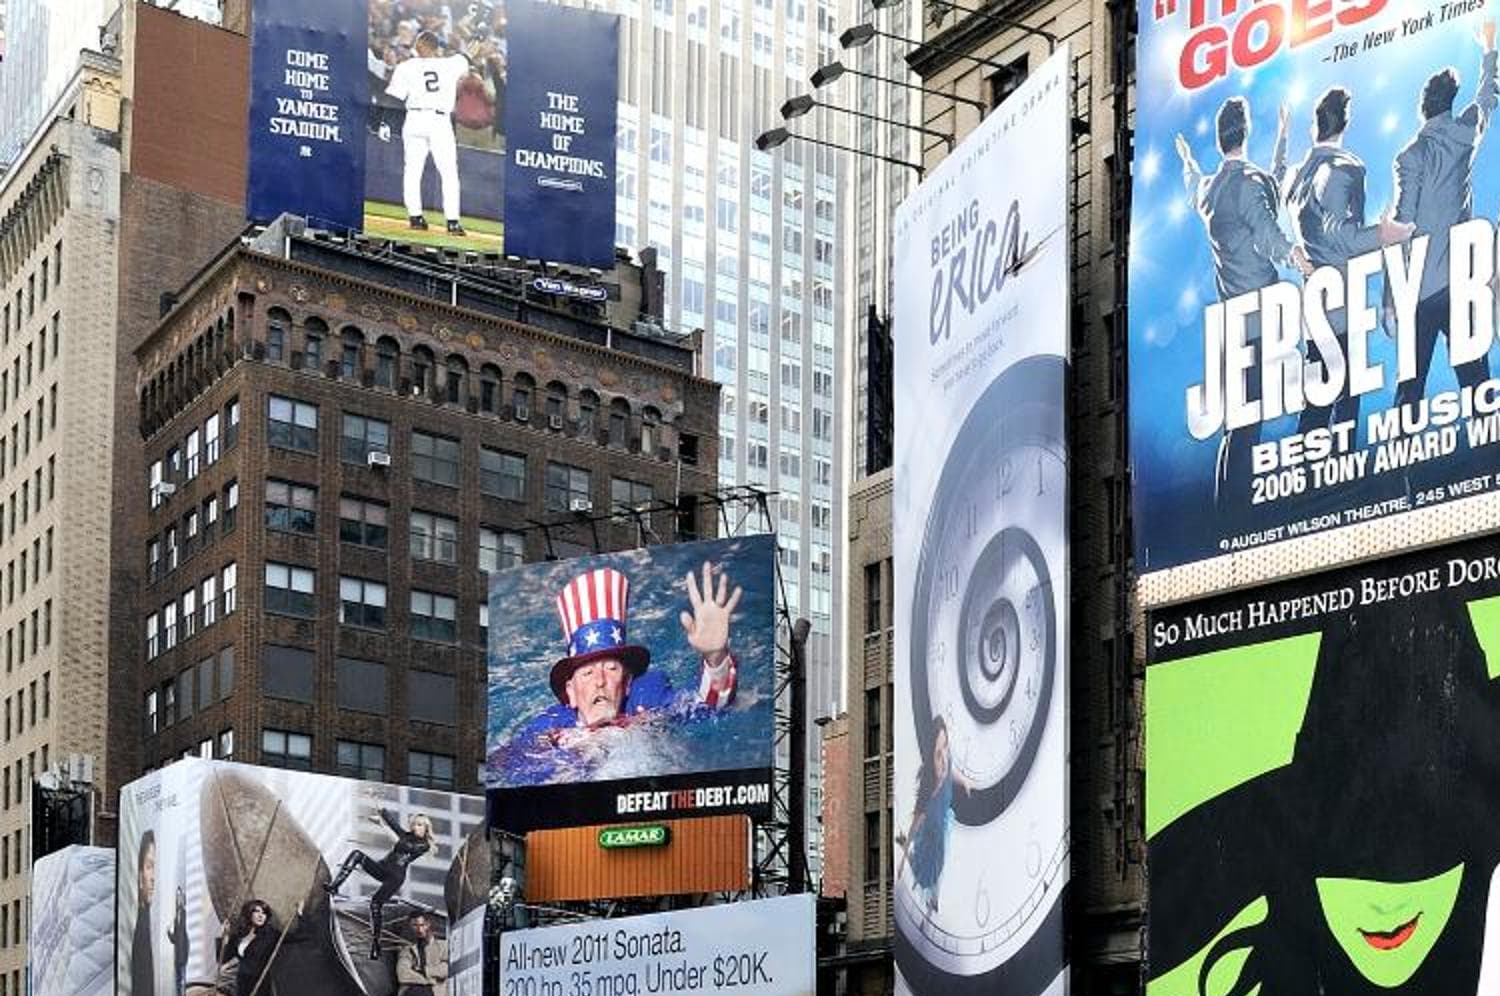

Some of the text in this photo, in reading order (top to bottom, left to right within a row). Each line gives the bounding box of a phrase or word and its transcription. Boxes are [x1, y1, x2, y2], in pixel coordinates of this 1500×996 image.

[1363, 0, 1485, 53] New York Times
[287, 49, 329, 71] COME
[285, 69, 329, 91] HOME
[300, 88, 313, 99] TO
[276, 97, 339, 121] YANKEE
[547, 91, 579, 113] THE
[540, 111, 585, 135] HOME
[552, 134, 572, 152] OF
[931, 198, 979, 268] BEING
[1186, 234, 1429, 441] JERSEY
[1252, 421, 1356, 475] BEST
[1251, 467, 1308, 505] 2006
[1313, 450, 1368, 488] TONY
[1231, 526, 1285, 550] AUGUST
[1287, 512, 1341, 537] WILSON
[1416, 488, 1444, 506] 245
[1448, 475, 1491, 498] WEST
[606, 828, 664, 845] LAMAR
[507, 943, 567, 971] All-new
[572, 932, 608, 965] 2011
[646, 960, 707, 994] Under
